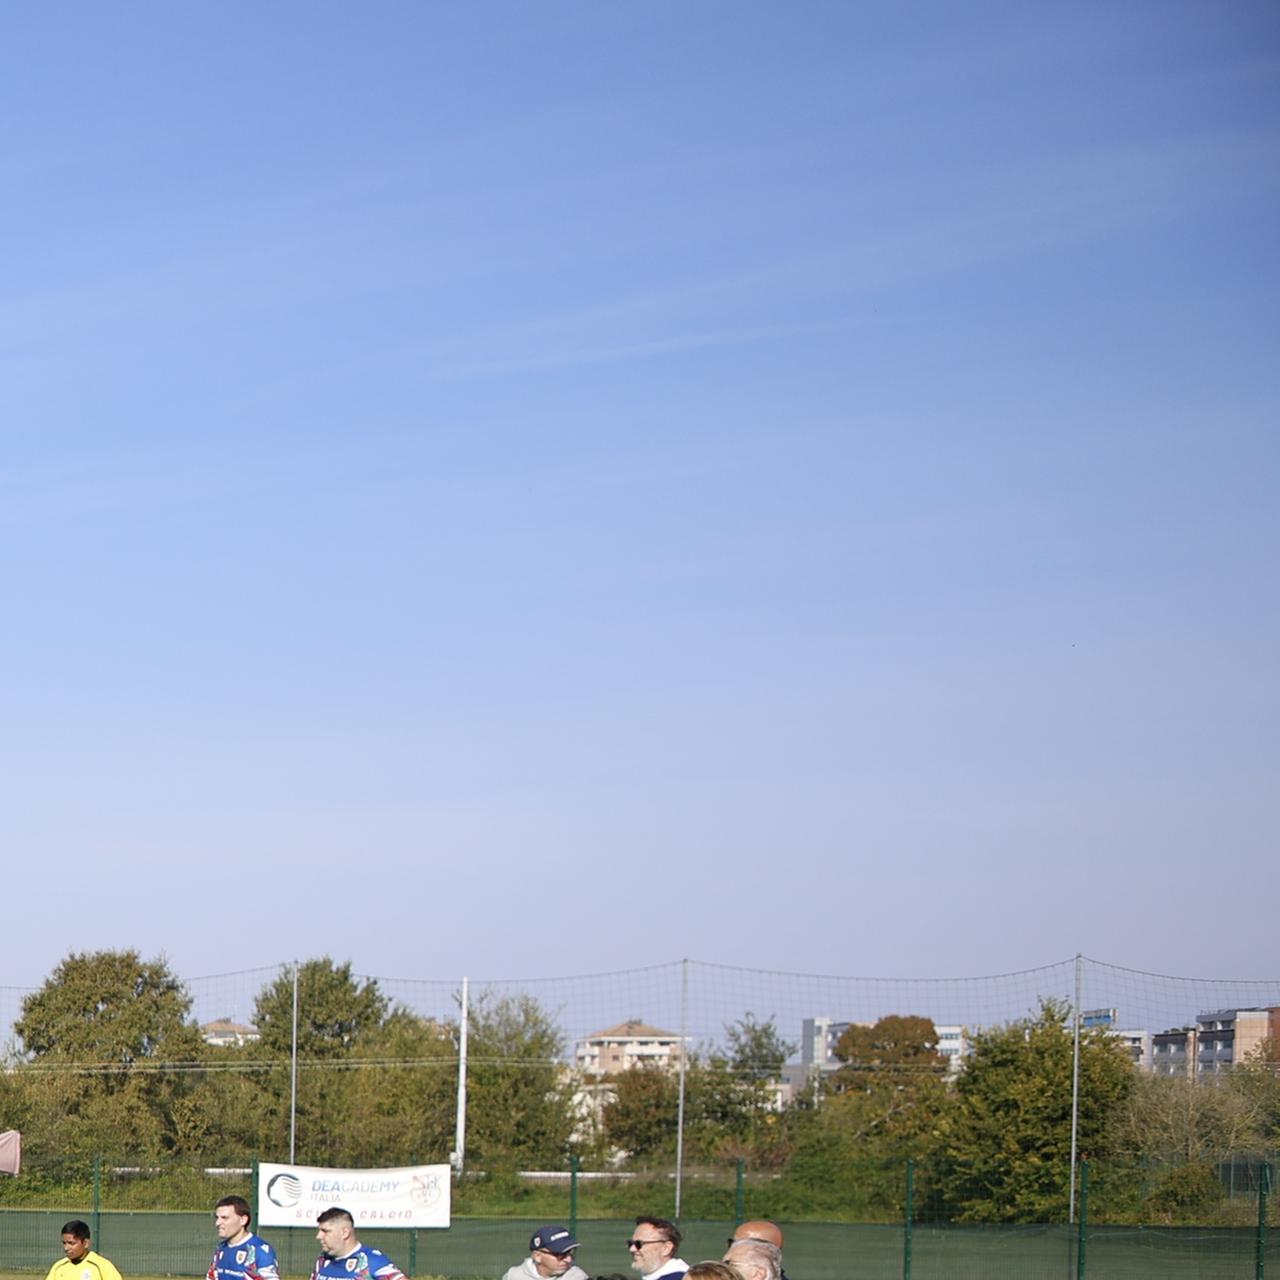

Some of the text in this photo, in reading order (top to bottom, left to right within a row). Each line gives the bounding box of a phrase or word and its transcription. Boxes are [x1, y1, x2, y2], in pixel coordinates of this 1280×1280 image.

[311, 1179, 400, 1193] DEACADEMY
[310, 1193, 341, 1202] ITALIA
[359, 1209, 413, 1220] CALCIO
